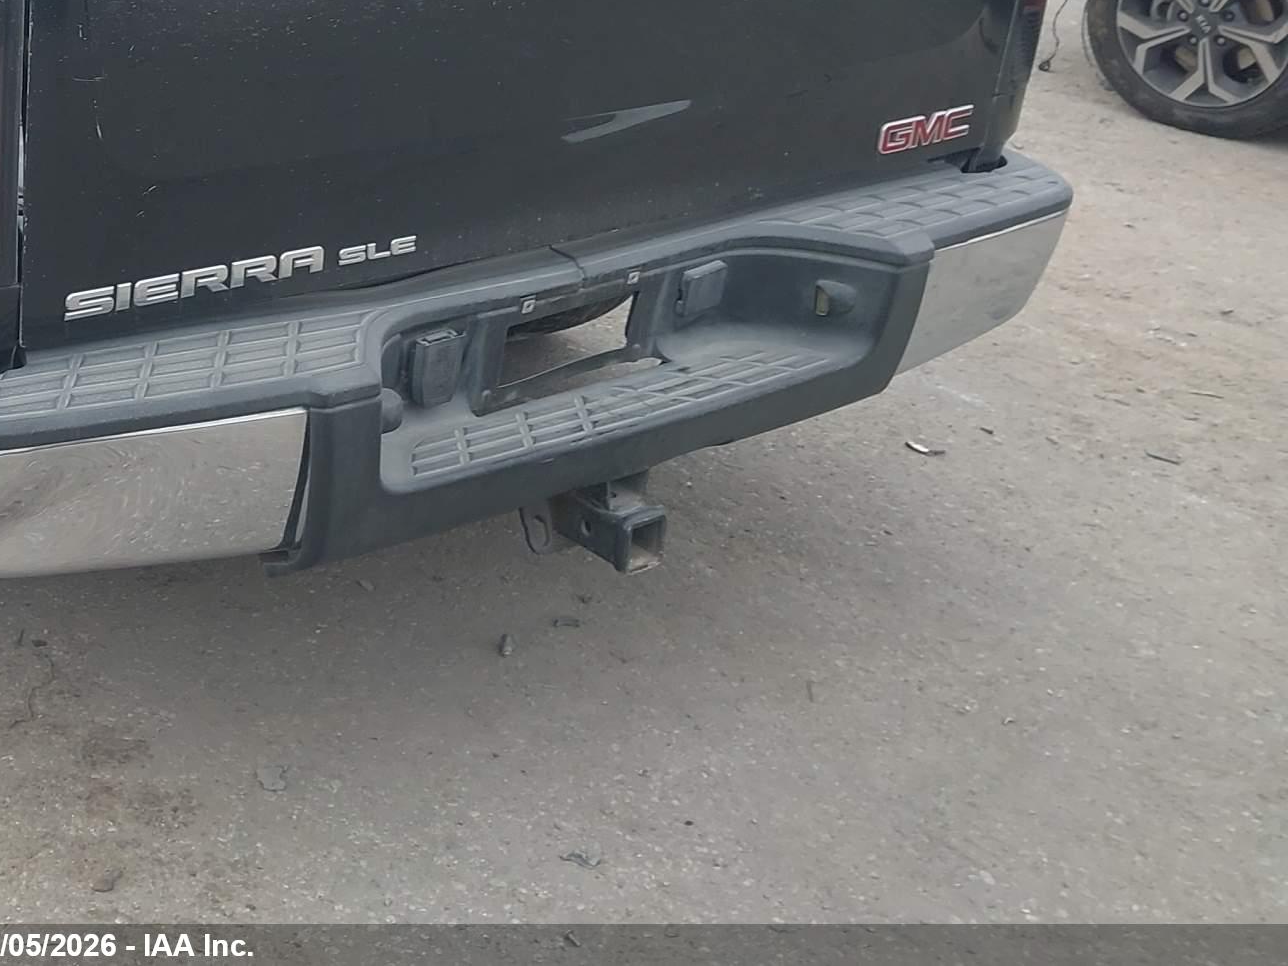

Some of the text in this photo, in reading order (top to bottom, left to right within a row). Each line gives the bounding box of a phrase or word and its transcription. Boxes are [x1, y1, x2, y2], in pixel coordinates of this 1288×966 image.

[878, 104, 974, 154] GMC
[63, 235, 417, 322] SIERRA SLE
